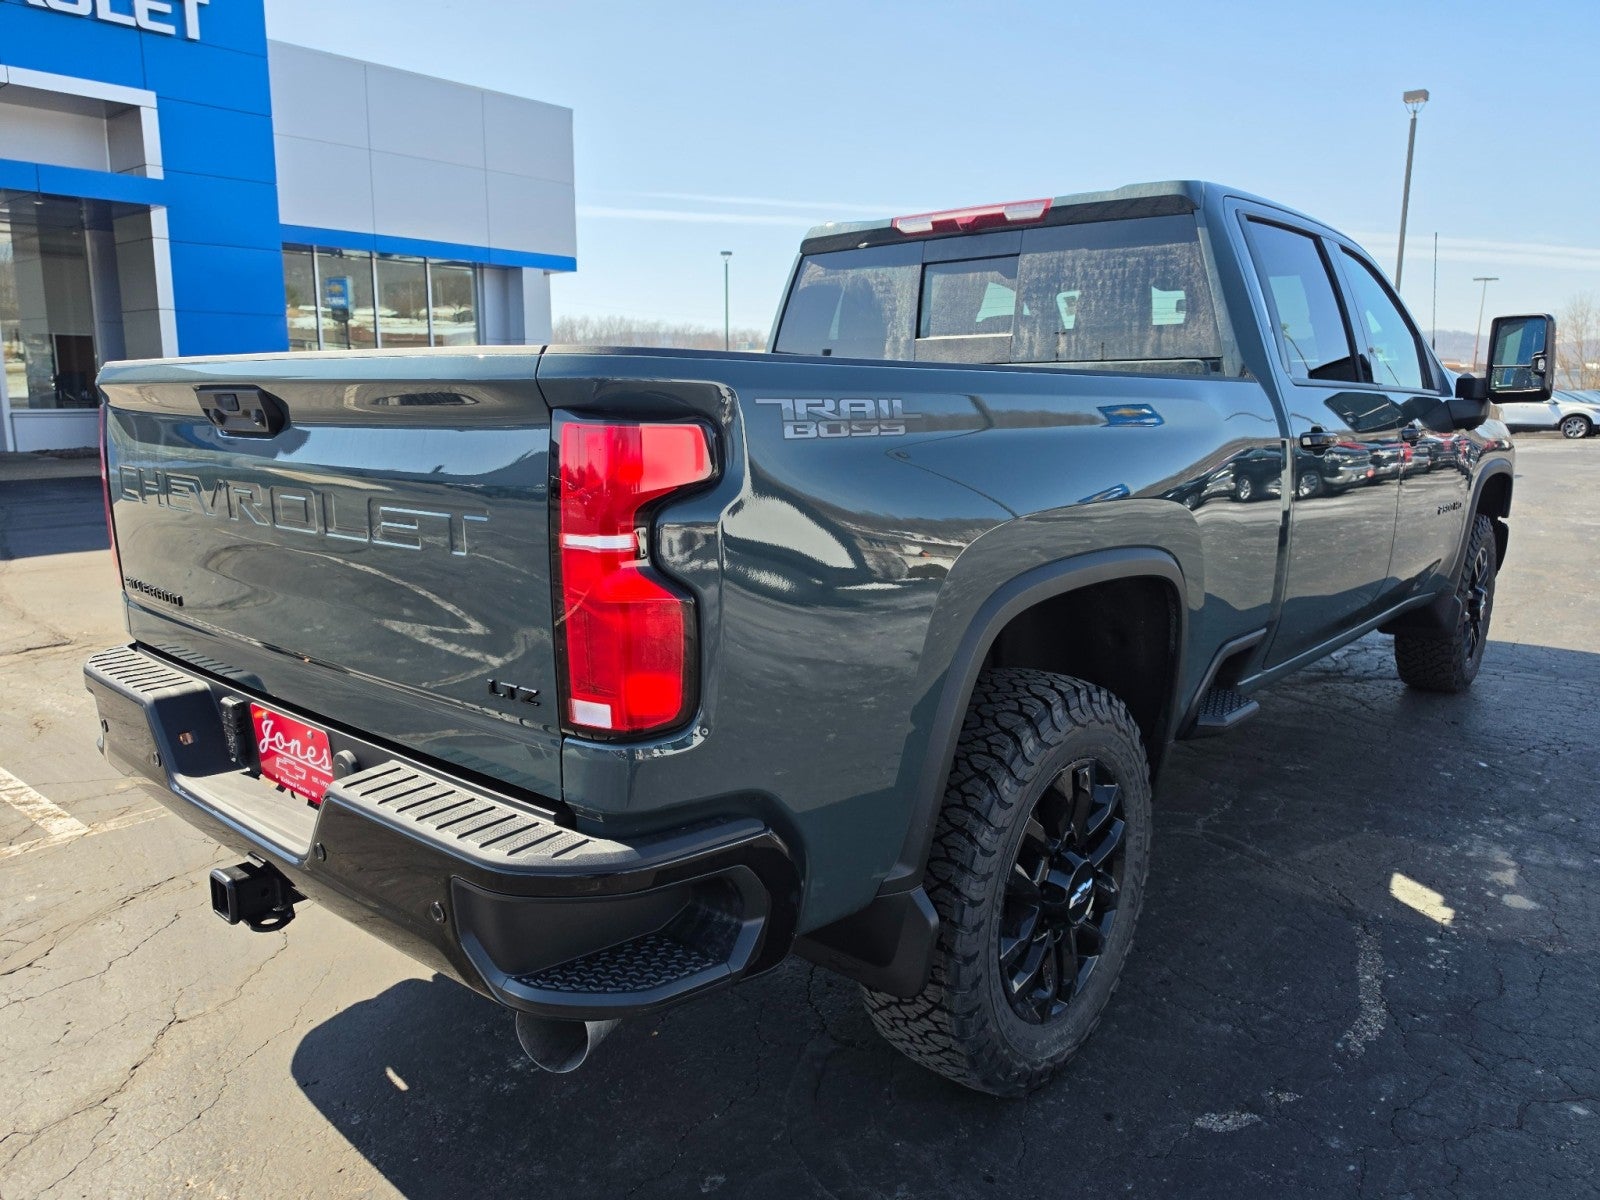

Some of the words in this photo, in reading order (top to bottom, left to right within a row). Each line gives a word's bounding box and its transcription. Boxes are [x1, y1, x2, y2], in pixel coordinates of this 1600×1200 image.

[755, 398, 922, 420] TRAIL
[783, 420, 906, 439] BOSS
[118, 465, 489, 556] CHEVROLET
[487, 679, 540, 706] LTZ
[259, 720, 332, 770] Jones
